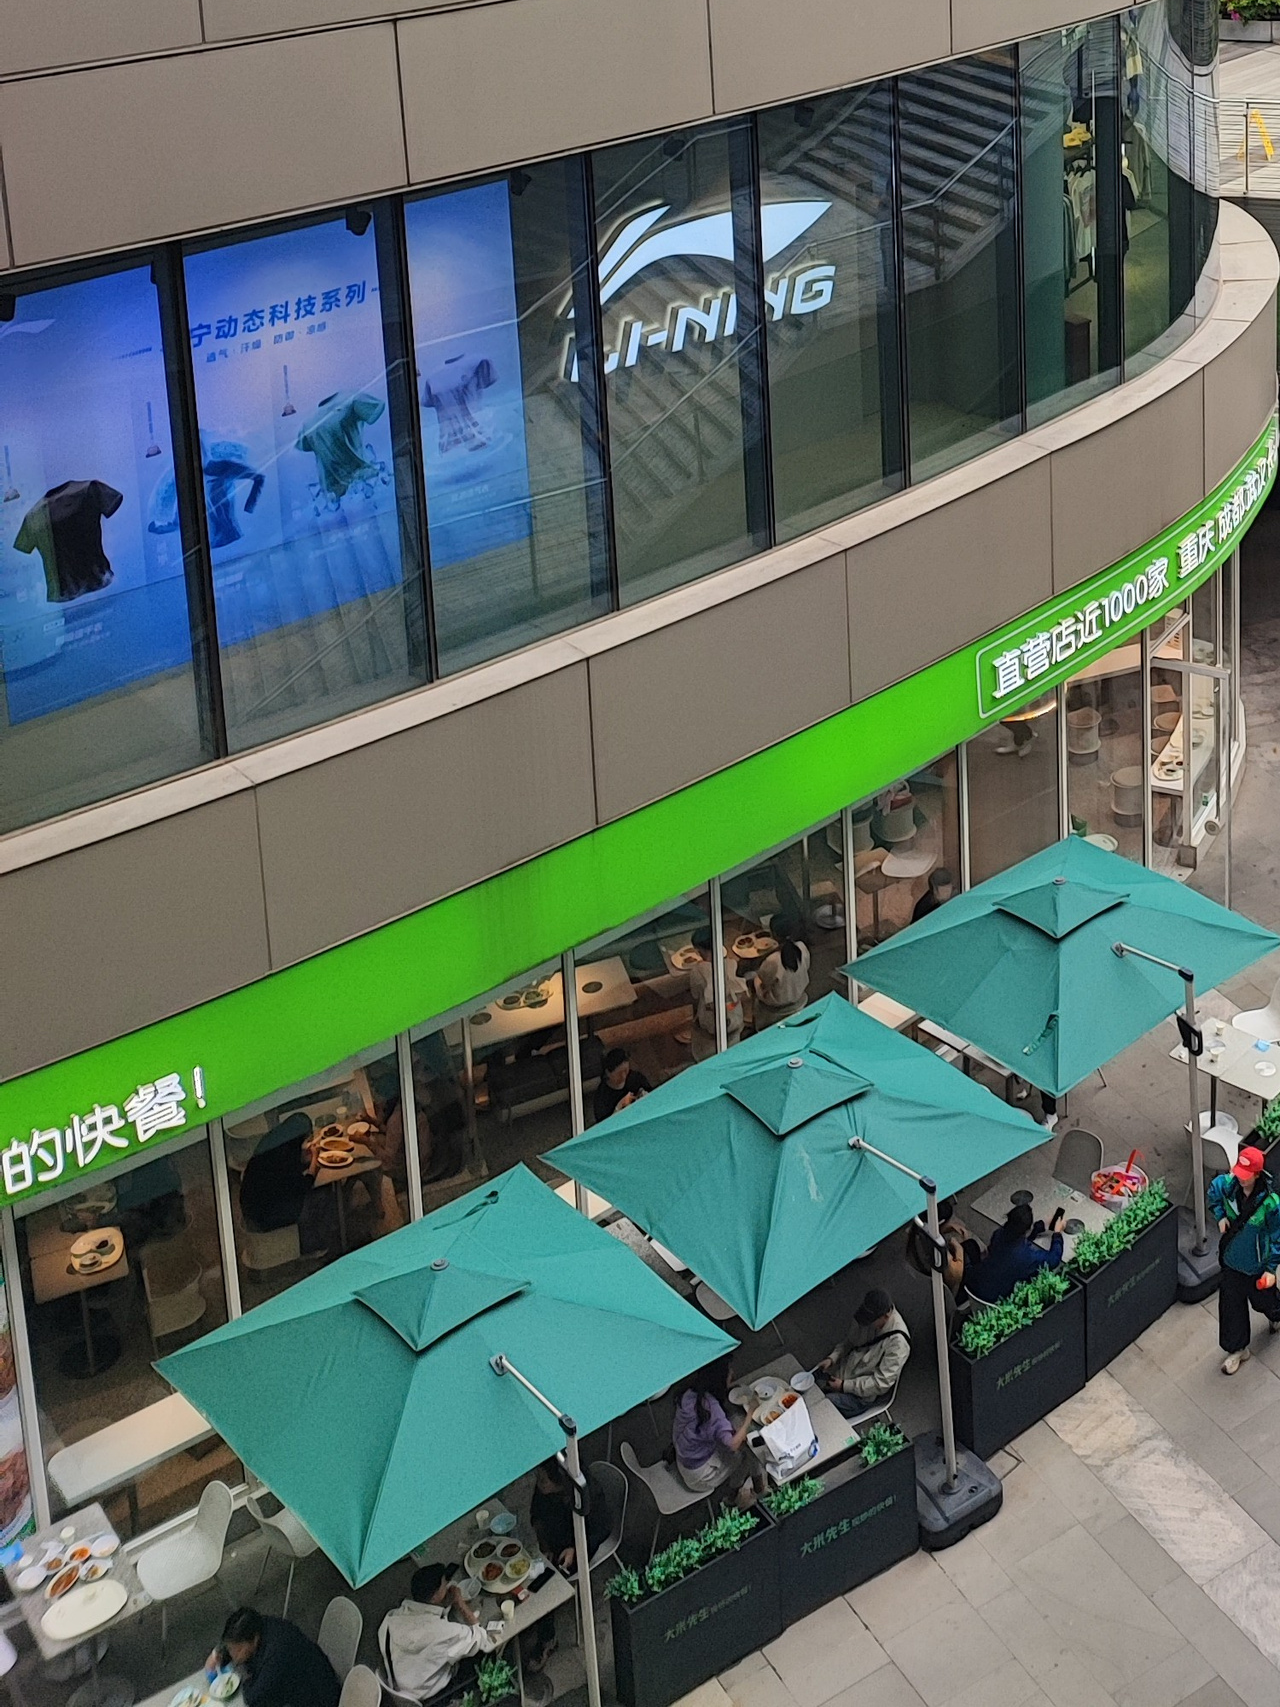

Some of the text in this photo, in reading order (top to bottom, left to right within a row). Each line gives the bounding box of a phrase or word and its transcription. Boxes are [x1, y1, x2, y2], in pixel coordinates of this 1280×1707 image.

[190, 280, 366, 348] 宁动态科技系列
[992, 556, 1170, 698] 直营店近1000家
